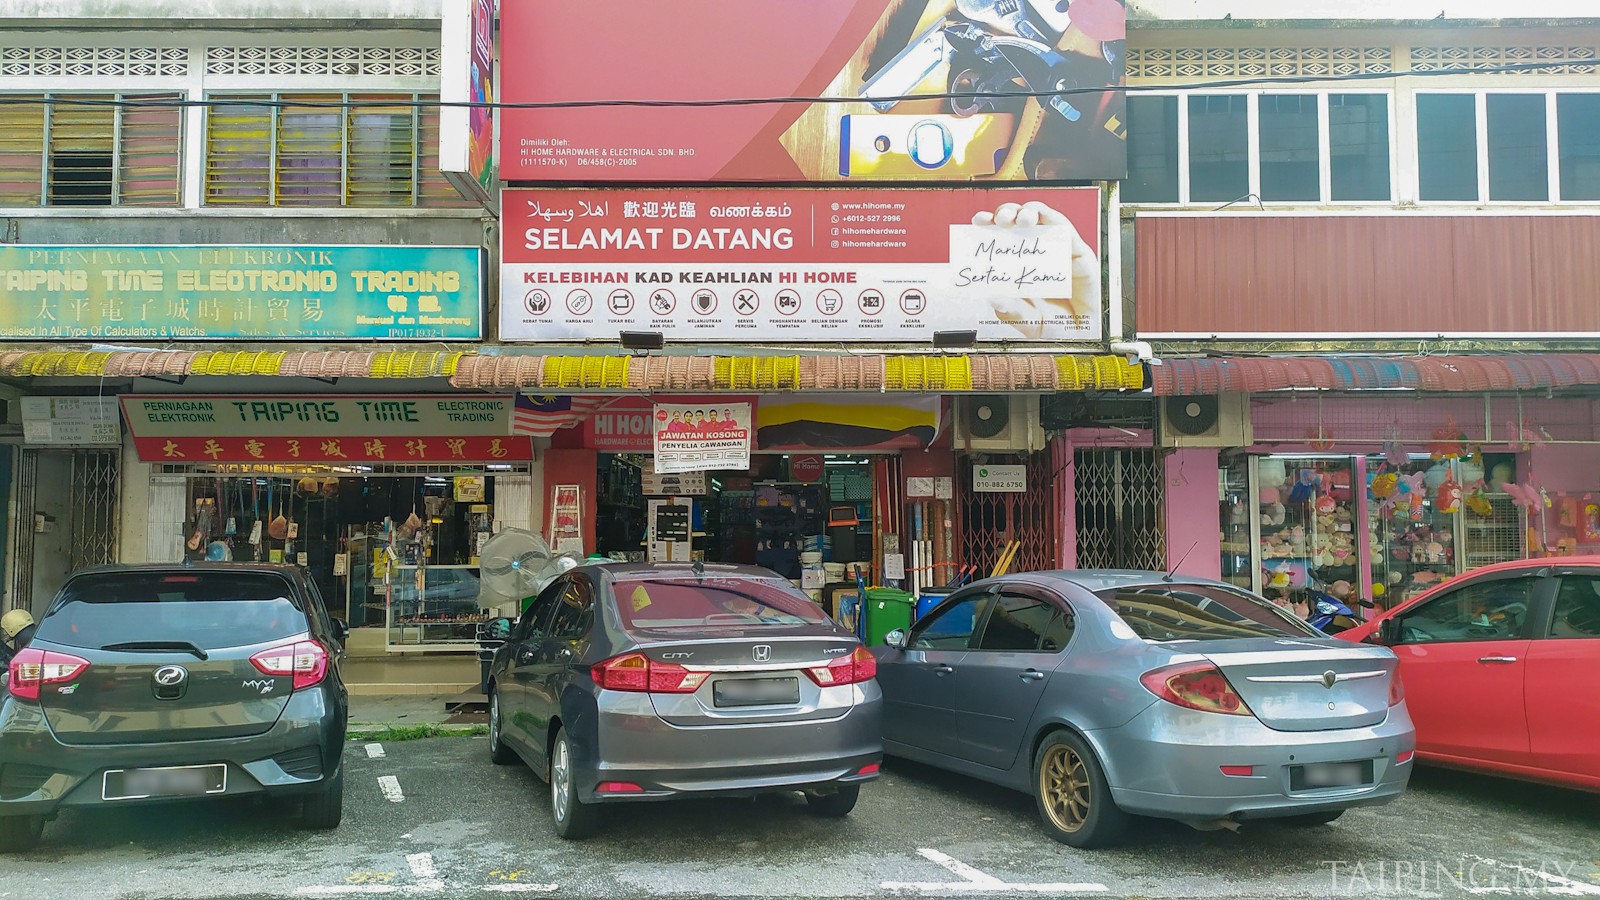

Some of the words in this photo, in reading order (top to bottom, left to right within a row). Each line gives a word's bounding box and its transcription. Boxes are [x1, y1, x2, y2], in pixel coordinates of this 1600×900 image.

[520, 138, 549, 146] Dimiliki
[551, 138, 570, 146] Oleh:
[520, 148, 529, 156] HI
[531, 148, 553, 156] HOME
[556, 148, 599, 156] HARDWARE
[601, 148, 607, 156] &
[609, 148, 655, 156] ELECTRICAL
[520, 158, 568, 166] (1111570-K)
[577, 158, 637, 166] D6/458(C)-2005
[623, 201, 696, 218] 歡迎光臨
[709, 202, 792, 218] வணக்கம்
[842, 202, 905, 210] www.hihome.my
[525, 228, 663, 250] SELAMAT
[672, 228, 794, 250] DATANG
[975, 237, 1046, 261] Marilah
[29, 250, 182, 265] PERNIAGAAN
[351, 270, 460, 293] TRADING
[523, 272, 629, 284] KELEBIHAN
[635, 272, 673, 284] KAD
[679, 272, 773, 284] KEAHLIAN
[779, 272, 798, 284] HI
[803, 272, 858, 284] HOME
[955, 266, 1011, 287] Sertai
[1014, 266, 1066, 290] Kami
[49, 325, 62, 337] All
[65, 325, 87, 338] Type
[90, 325, 102, 337] Of
[104, 325, 158, 337] Calculators
[160, 326, 168, 337] &
[170, 326, 208, 337] Watchs.
[143, 402, 214, 411] PERNIAGAAN
[231, 401, 340, 423] TAIPING
[356, 401, 420, 423] TIME
[437, 401, 504, 411] ELECTRONIC
[148, 413, 216, 423] ELEKTRONIK
[447, 413, 495, 423] TRADING
[594, 414, 613, 435] HI
[594, 437, 629, 446] HARDWARE
[660, 431, 704, 440] JAWATAN
[706, 431, 745, 439] KOSONG
[162, 438, 508, 460] 太平電子城時計貿易
[699, 441, 743, 449] CAWANGAN
